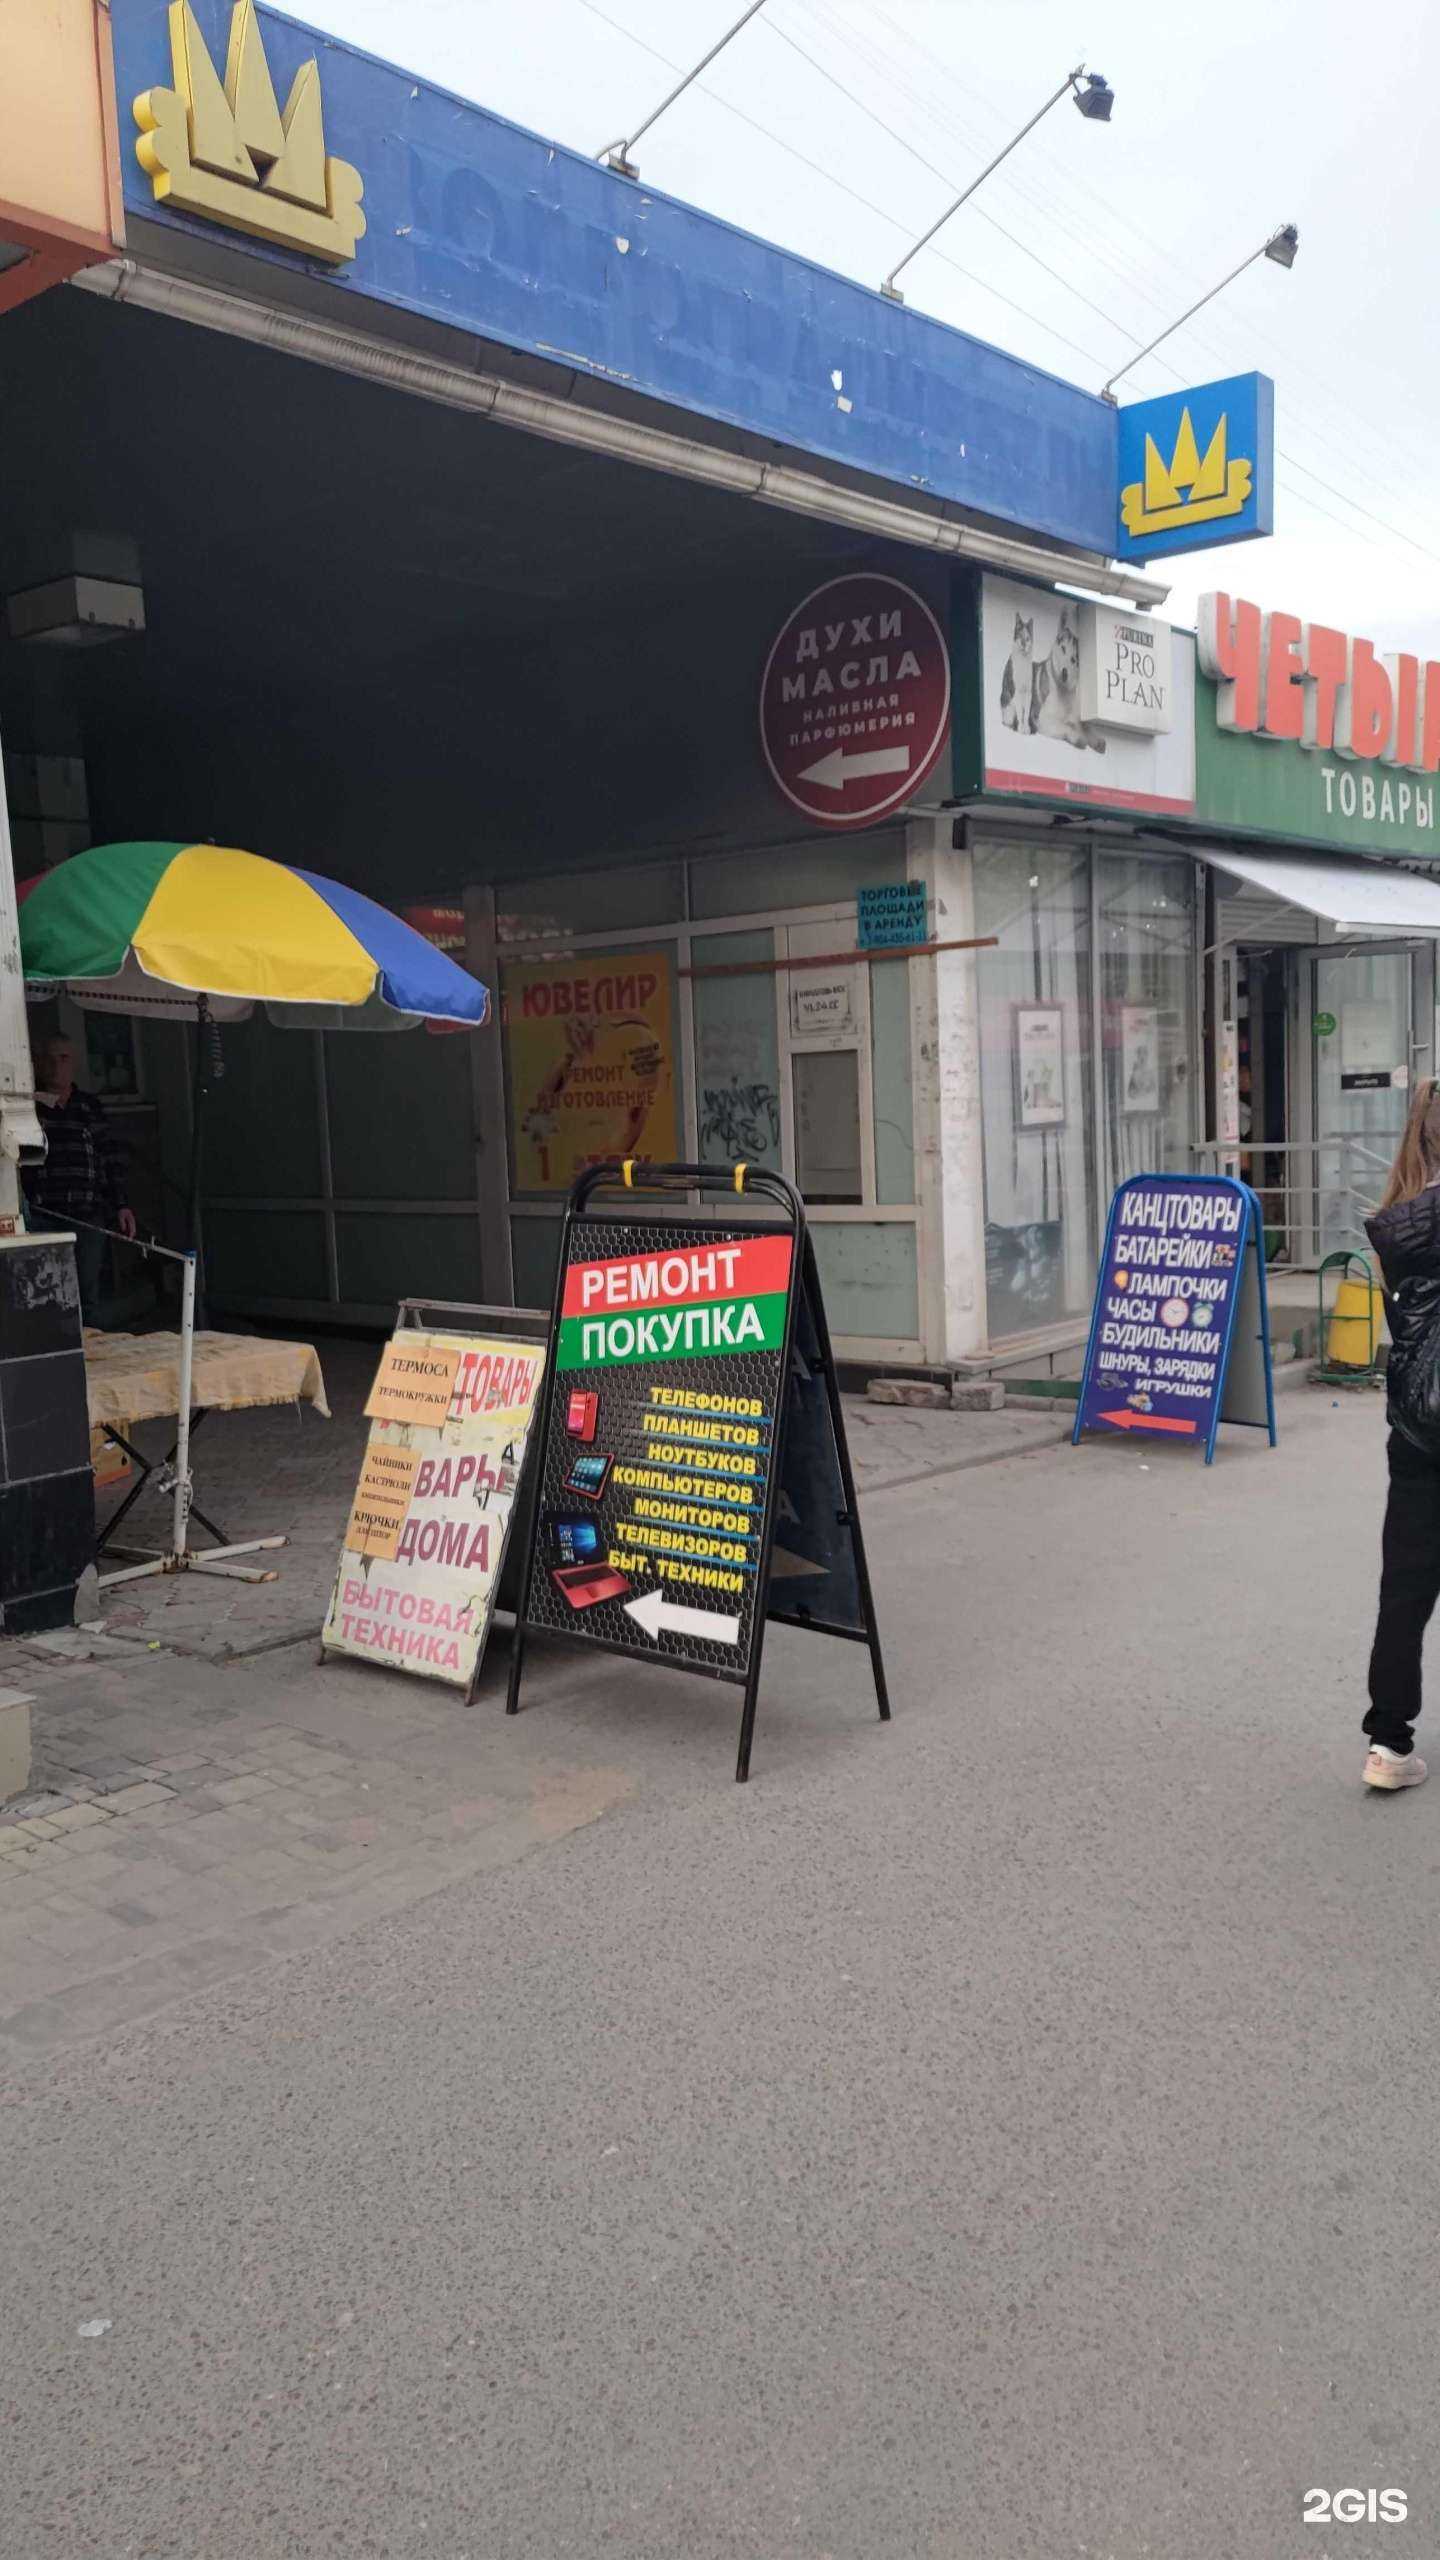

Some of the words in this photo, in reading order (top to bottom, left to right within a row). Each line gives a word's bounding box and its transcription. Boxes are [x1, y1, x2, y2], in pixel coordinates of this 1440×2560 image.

[796, 610, 902, 663] ДУХИ
[782, 651, 921, 703] МАСЛА
[1116, 642, 1155, 679] PRO
[1106, 669, 1164, 711] PLAN
[803, 694, 899, 723] НАЛИВНАЯ
[790, 712, 915, 746] ПАРФЮМЕРИЯ
[1321, 767, 1434, 829] ТОВАРЫ
[861, 900, 924, 916] ПЛОЩАДИ
[864, 921, 871, 931] В
[875, 915, 920, 930] АРЕНДУ
[522, 973, 658, 1018] ЮВЕЛИР
[564, 1064, 625, 1084] РЕМОНТ
[1121, 1191, 1242, 1235] КАНЦТОВАРЫ
[1115, 1233, 1213, 1269] БАТАРЕЙКИ
[582, 1248, 741, 1308] РЕМОНТ
[1128, 1273, 1227, 1301] ЛАМПОЧКИ
[1107, 1298, 1156, 1322] ЧАСЫ
[582, 1302, 766, 1361] ПОКУПКА
[1101, 1322, 1220, 1355] БУДИЛЬНИКИ
[391, 1358, 449, 1377] ТЕРМОСА
[456, 1353, 538, 1415] ТОВАРЫ
[1099, 1351, 1151, 1375] ШНУРЫ,
[1154, 1357, 1216, 1381] ЗАРЯДКИ
[378, 1386, 447, 1405] ТЕРМОКРУЖКИ
[651, 1386, 763, 1417] ТЕЛЕФОНОВ
[1134, 1378, 1212, 1398] ИГРУШКИ
[643, 1414, 759, 1446] ПЛАНШЕТОВ
[372, 1455, 412, 1471] ЧАЙНИКИ
[414, 1454, 513, 1497] ВАРЫ
[648, 1444, 756, 1475] НОУТБУКОВ
[364, 1474, 411, 1491] КАСТРЮЛИ
[613, 1465, 753, 1504] КОМПЬЮТЕРОВ
[354, 1510, 400, 1530] КРЮЧКИ
[634, 1498, 750, 1534] МОНИТОРОВ
[394, 1518, 490, 1573] ДОМА
[616, 1522, 747, 1563] ТЕЛЕВИЗОРОВ
[608, 1549, 651, 1574] БЫТ.
[657, 1558, 743, 1593] ТЕХНИКИ
[342, 1579, 474, 1635] БЫТОВАЯ
[341, 1613, 459, 1670] ТЕХНИКА
